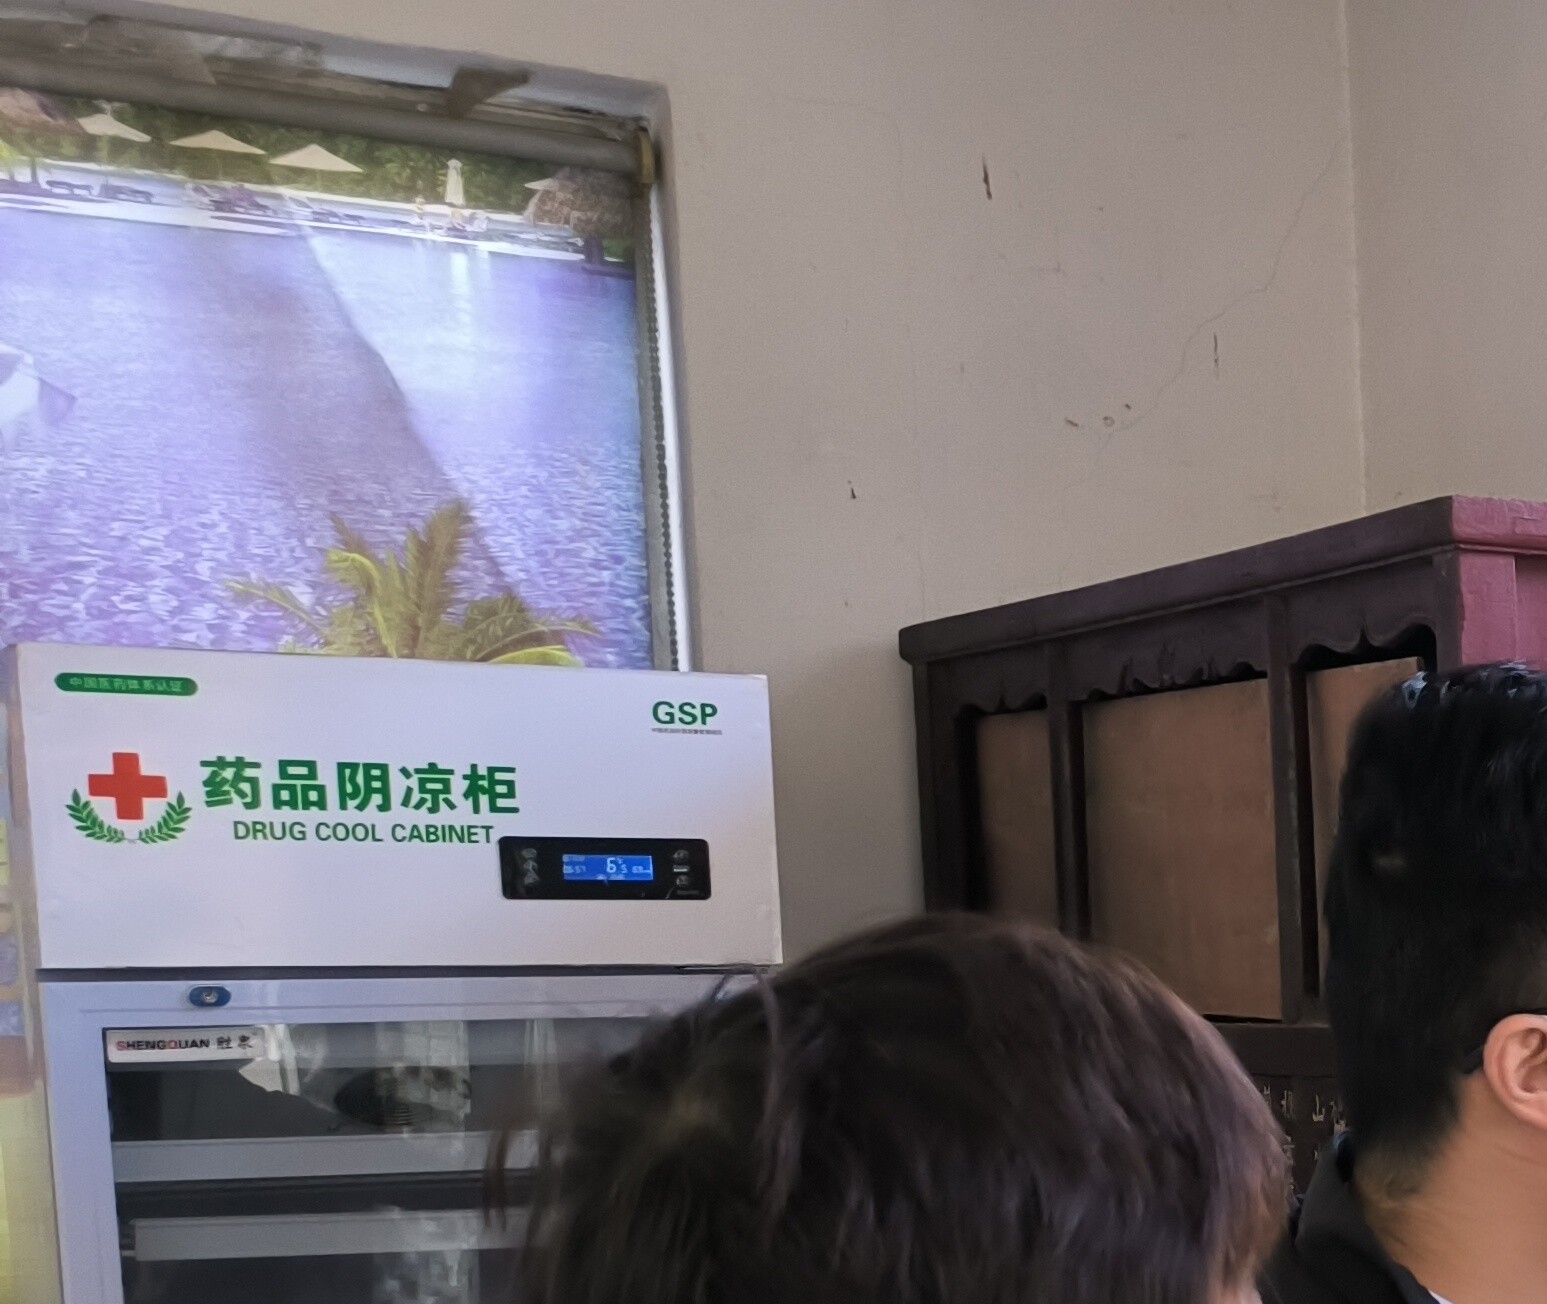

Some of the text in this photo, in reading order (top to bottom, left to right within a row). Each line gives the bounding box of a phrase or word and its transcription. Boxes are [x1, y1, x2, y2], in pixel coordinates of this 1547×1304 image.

[652, 701, 718, 726] GSP
[199, 755, 521, 815] 药品阴凉柜
[233, 820, 494, 844] DRUG COOL CABINET
[116, 1038, 211, 1051] SHENGQUAN
